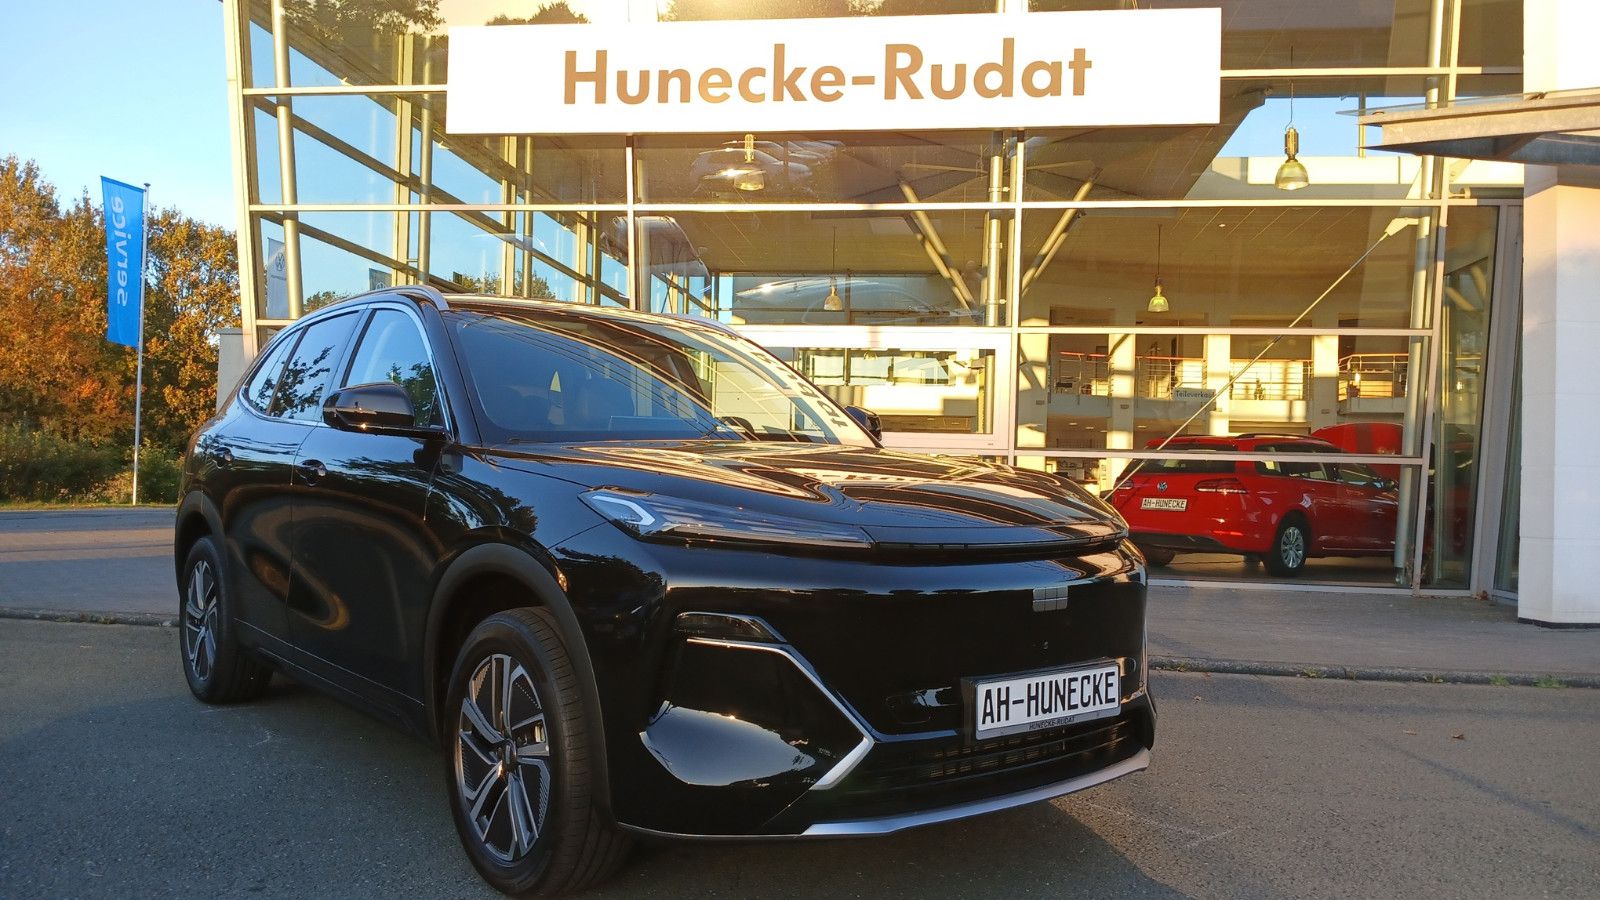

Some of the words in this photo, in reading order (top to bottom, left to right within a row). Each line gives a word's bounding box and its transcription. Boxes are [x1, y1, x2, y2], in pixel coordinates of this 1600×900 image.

[563, 38, 1093, 105] Hunecke-Rudat
[1143, 499, 1186, 509] AH-HUNECKE
[981, 671, 1116, 724] AH-HUNECKE
[1028, 716, 1076, 730] HUNECKE-RUDAT
